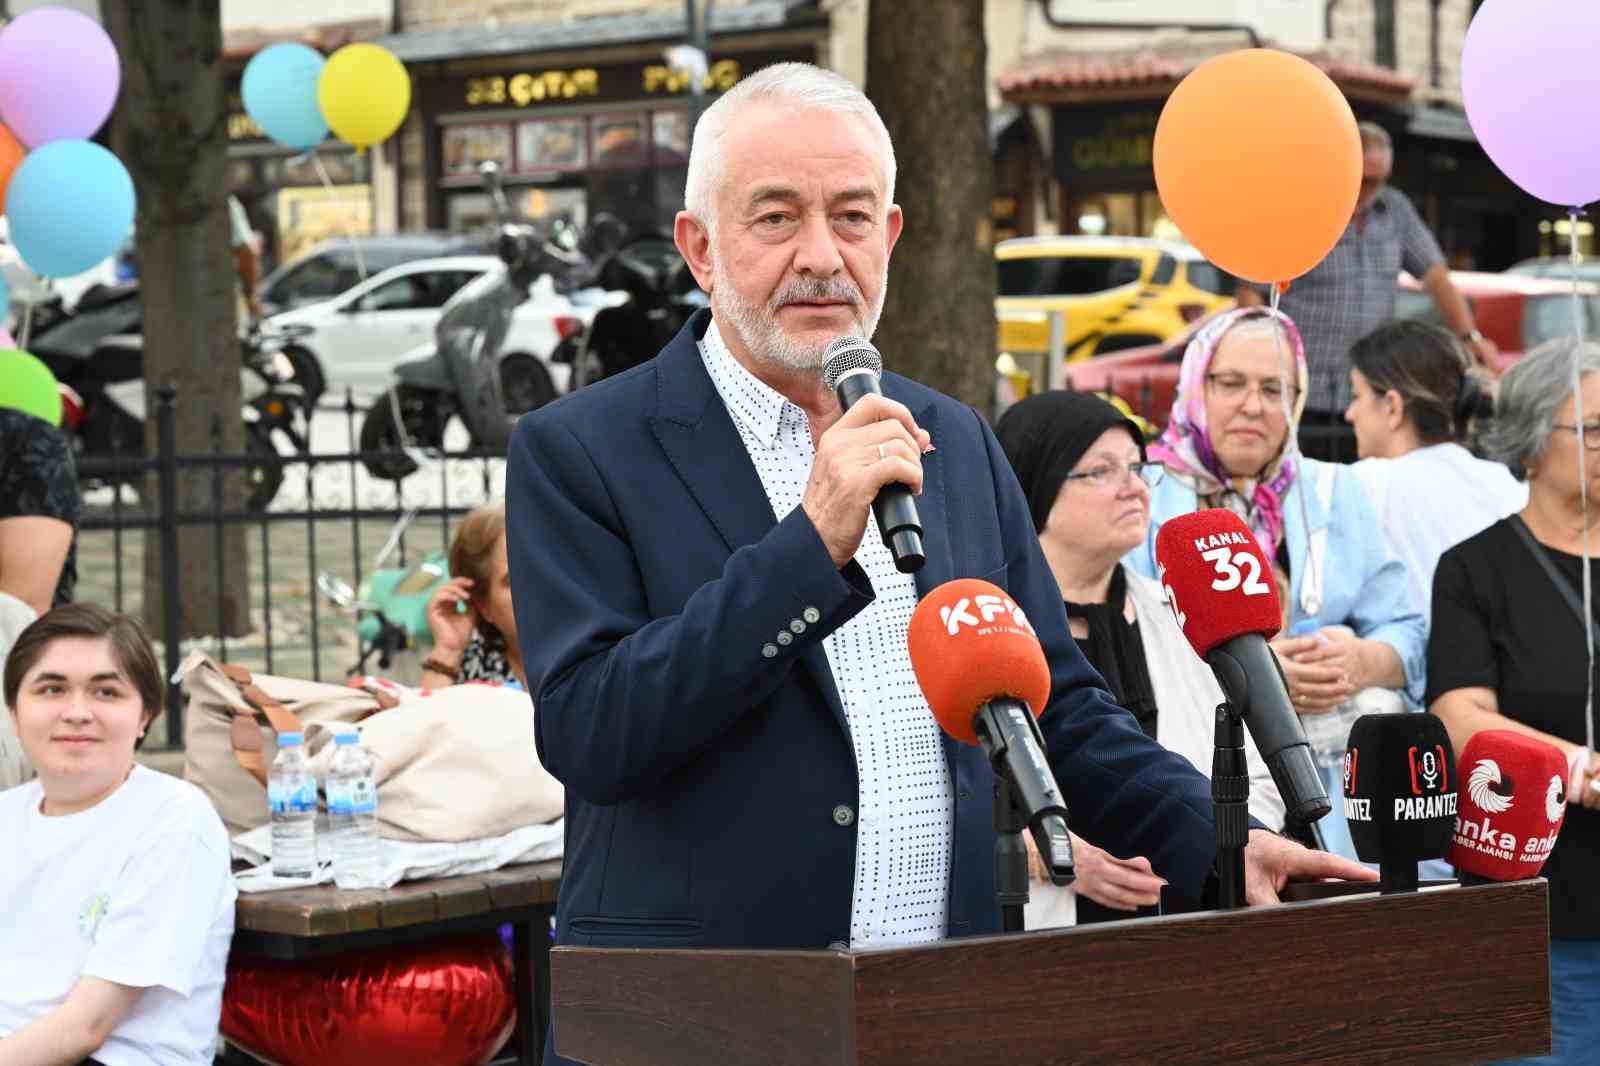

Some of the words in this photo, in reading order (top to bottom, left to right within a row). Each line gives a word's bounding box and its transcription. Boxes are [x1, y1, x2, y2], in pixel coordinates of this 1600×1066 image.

[1194, 532, 1250, 551] KANAL
[1201, 546, 1271, 596] 32
[1394, 792, 1458, 820] PARANTEZ
